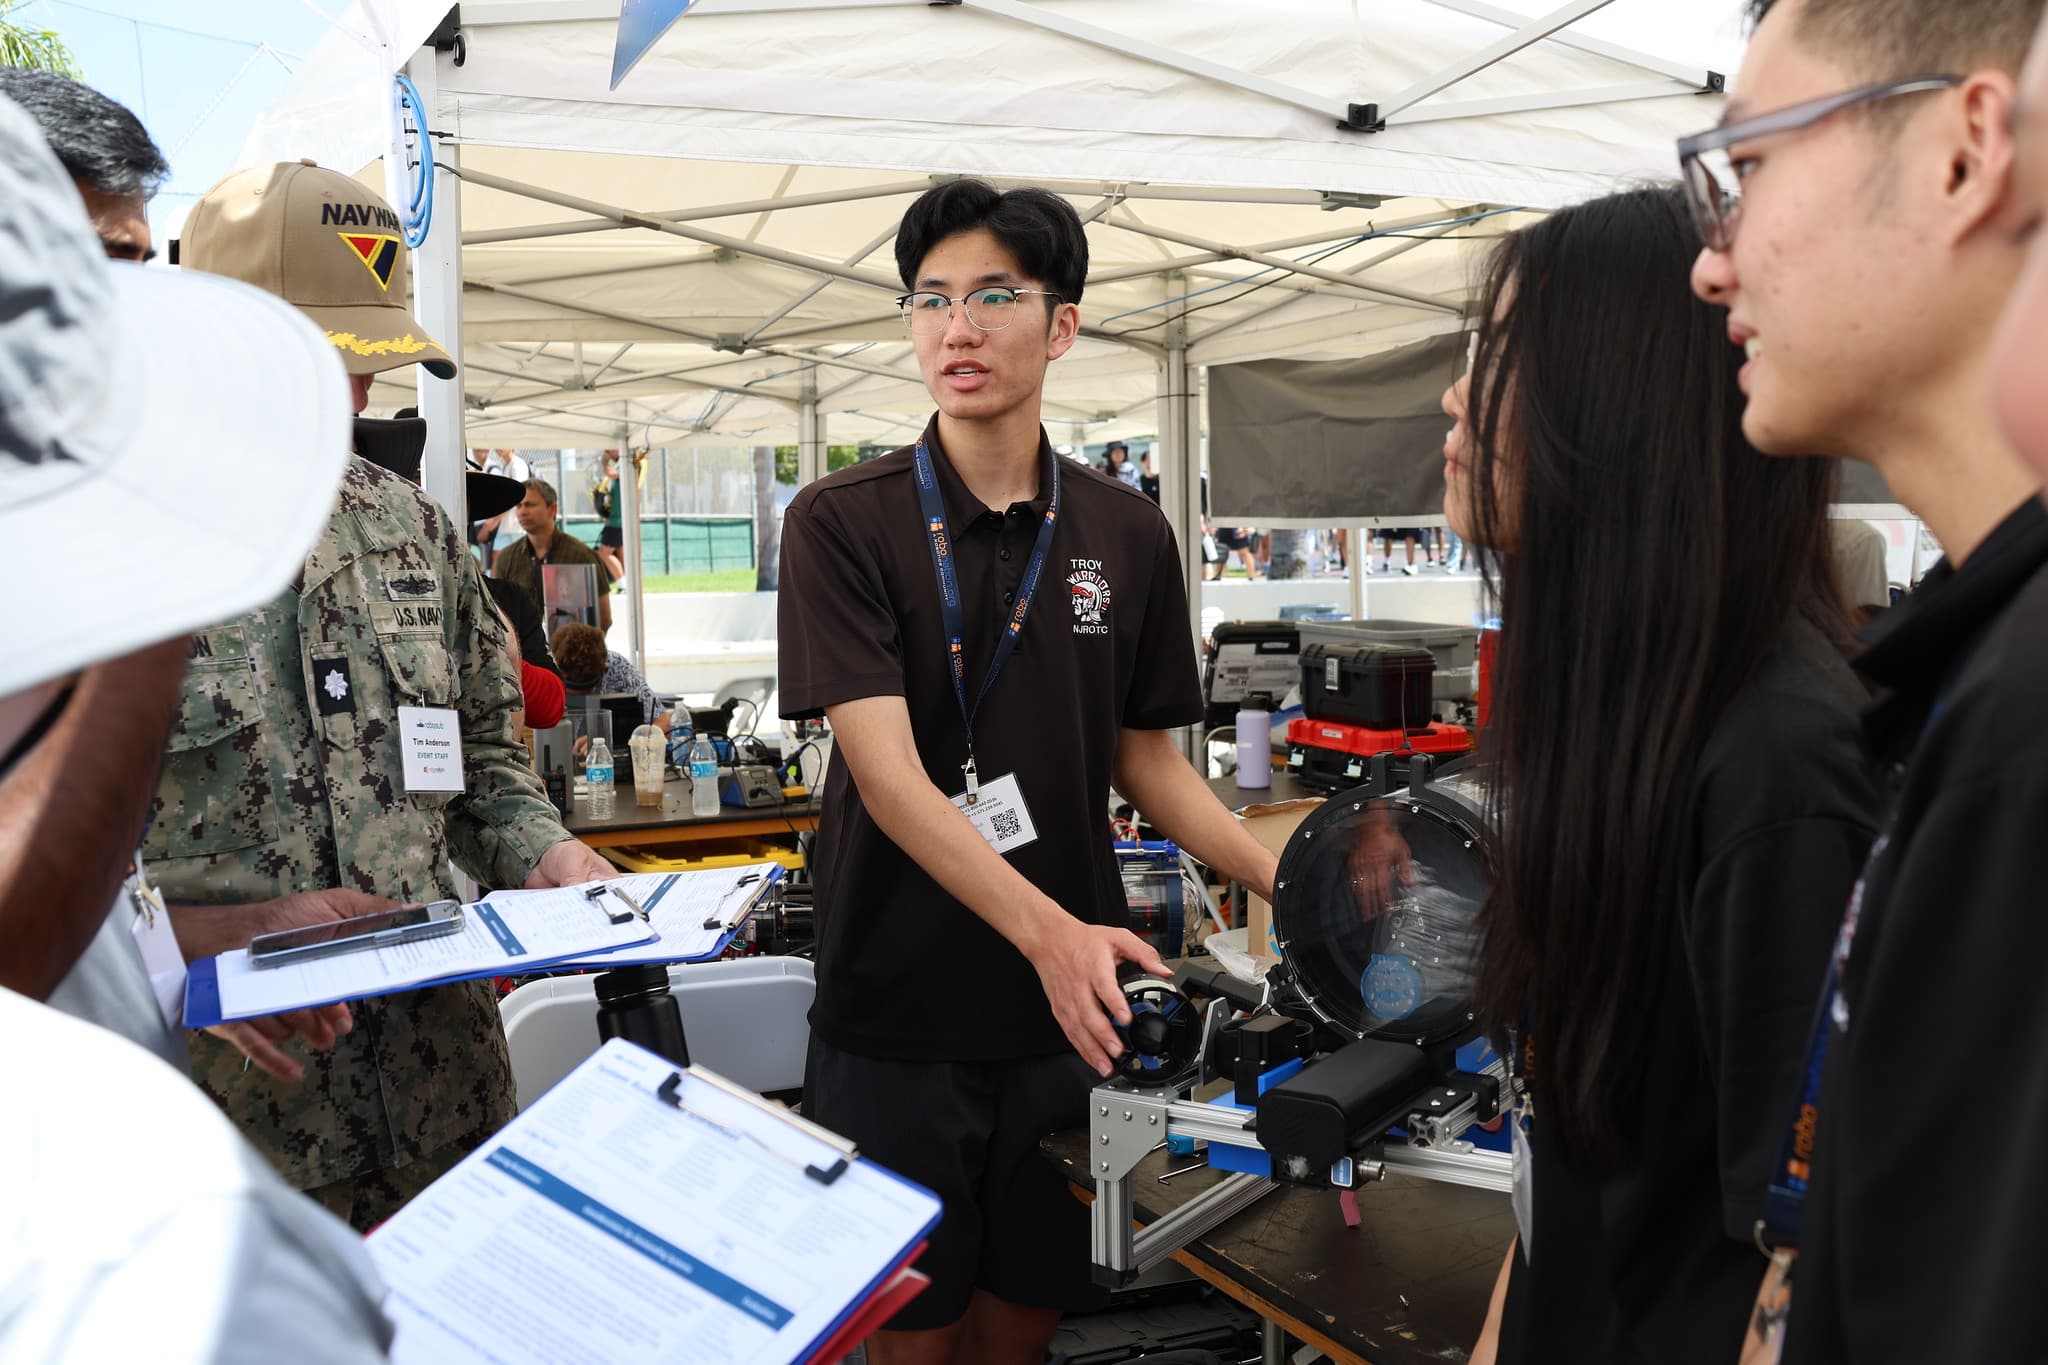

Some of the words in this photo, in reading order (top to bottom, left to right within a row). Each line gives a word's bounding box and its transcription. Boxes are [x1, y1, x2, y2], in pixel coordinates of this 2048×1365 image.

[1070, 559, 1103, 571] TROY
[1066, 570, 1111, 605] WARRIORS
[393, 607, 417, 627] U.S.
[1073, 624, 1108, 634] NJROTC
[413, 738, 424, 746] Tim
[425, 739, 450, 747] Anderson
